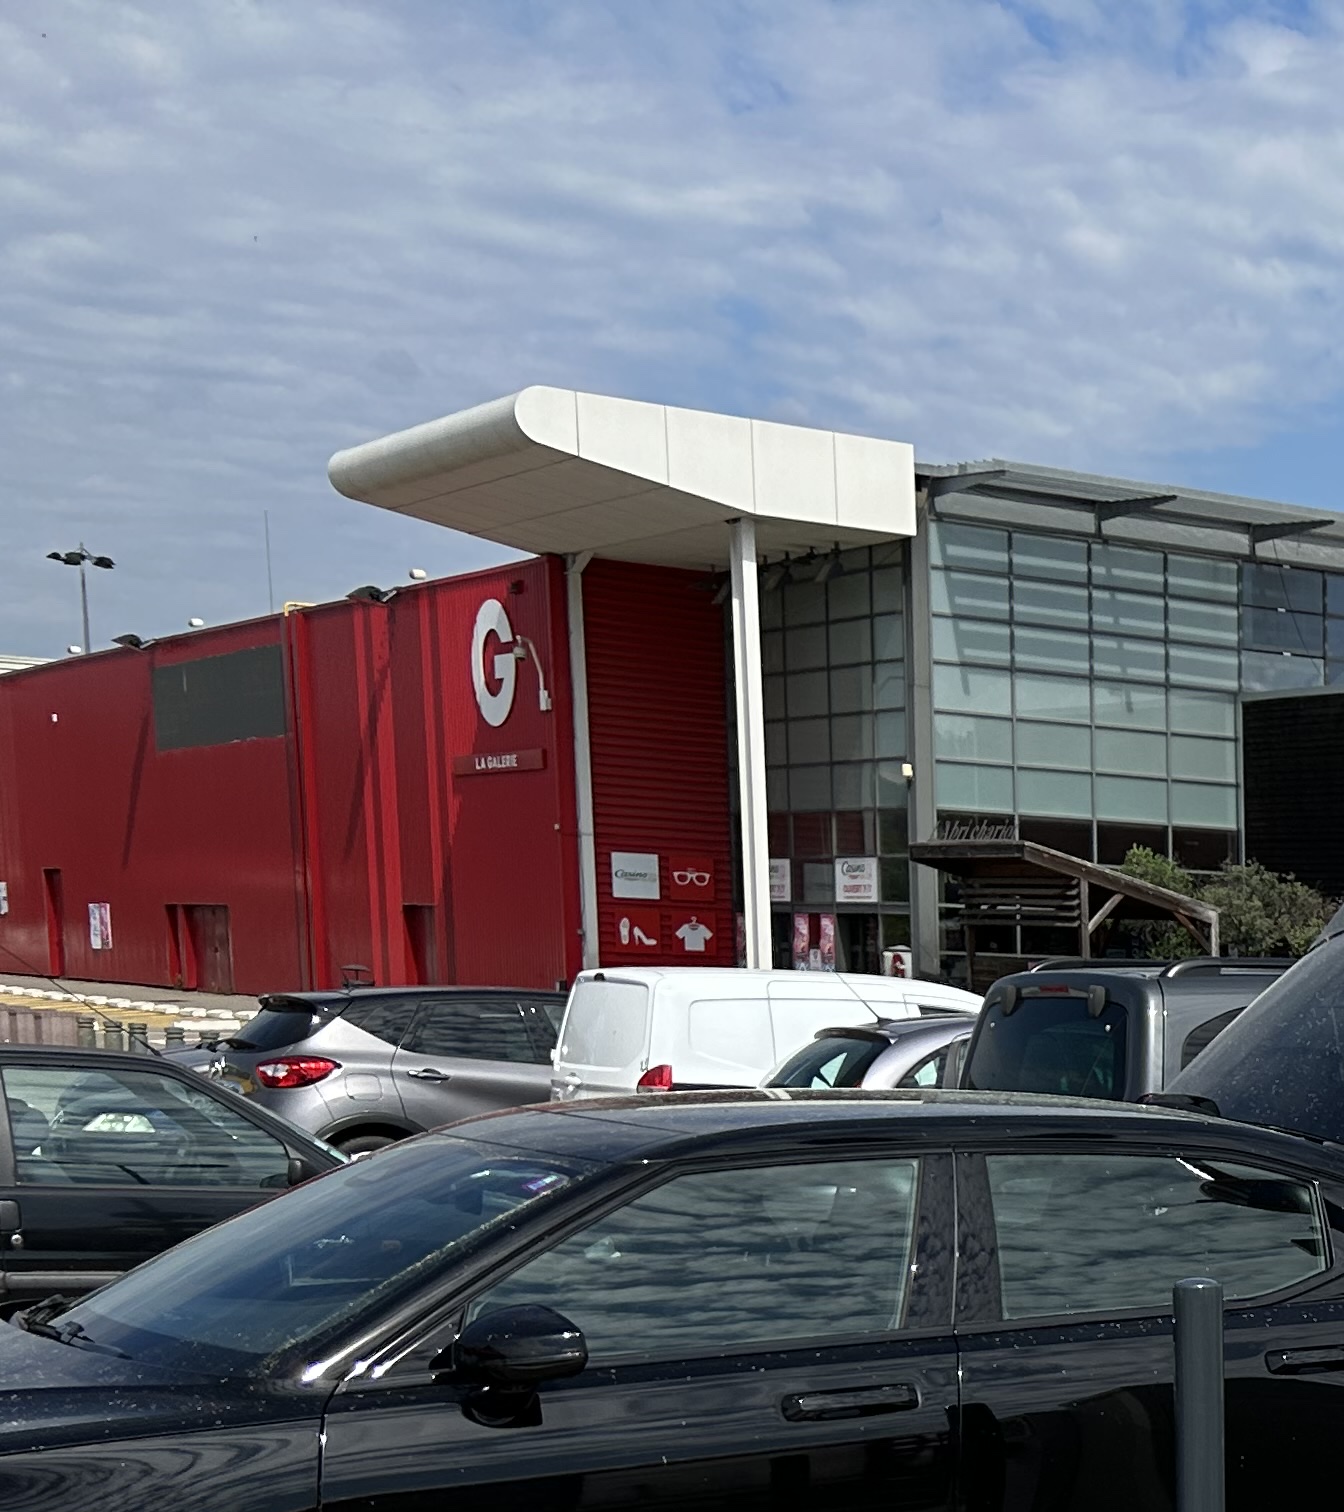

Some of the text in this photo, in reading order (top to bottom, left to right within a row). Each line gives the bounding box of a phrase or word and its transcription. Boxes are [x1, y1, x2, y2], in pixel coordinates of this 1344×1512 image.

[471, 599, 516, 727] G
[475, 754, 518, 769] LA GALERIE
